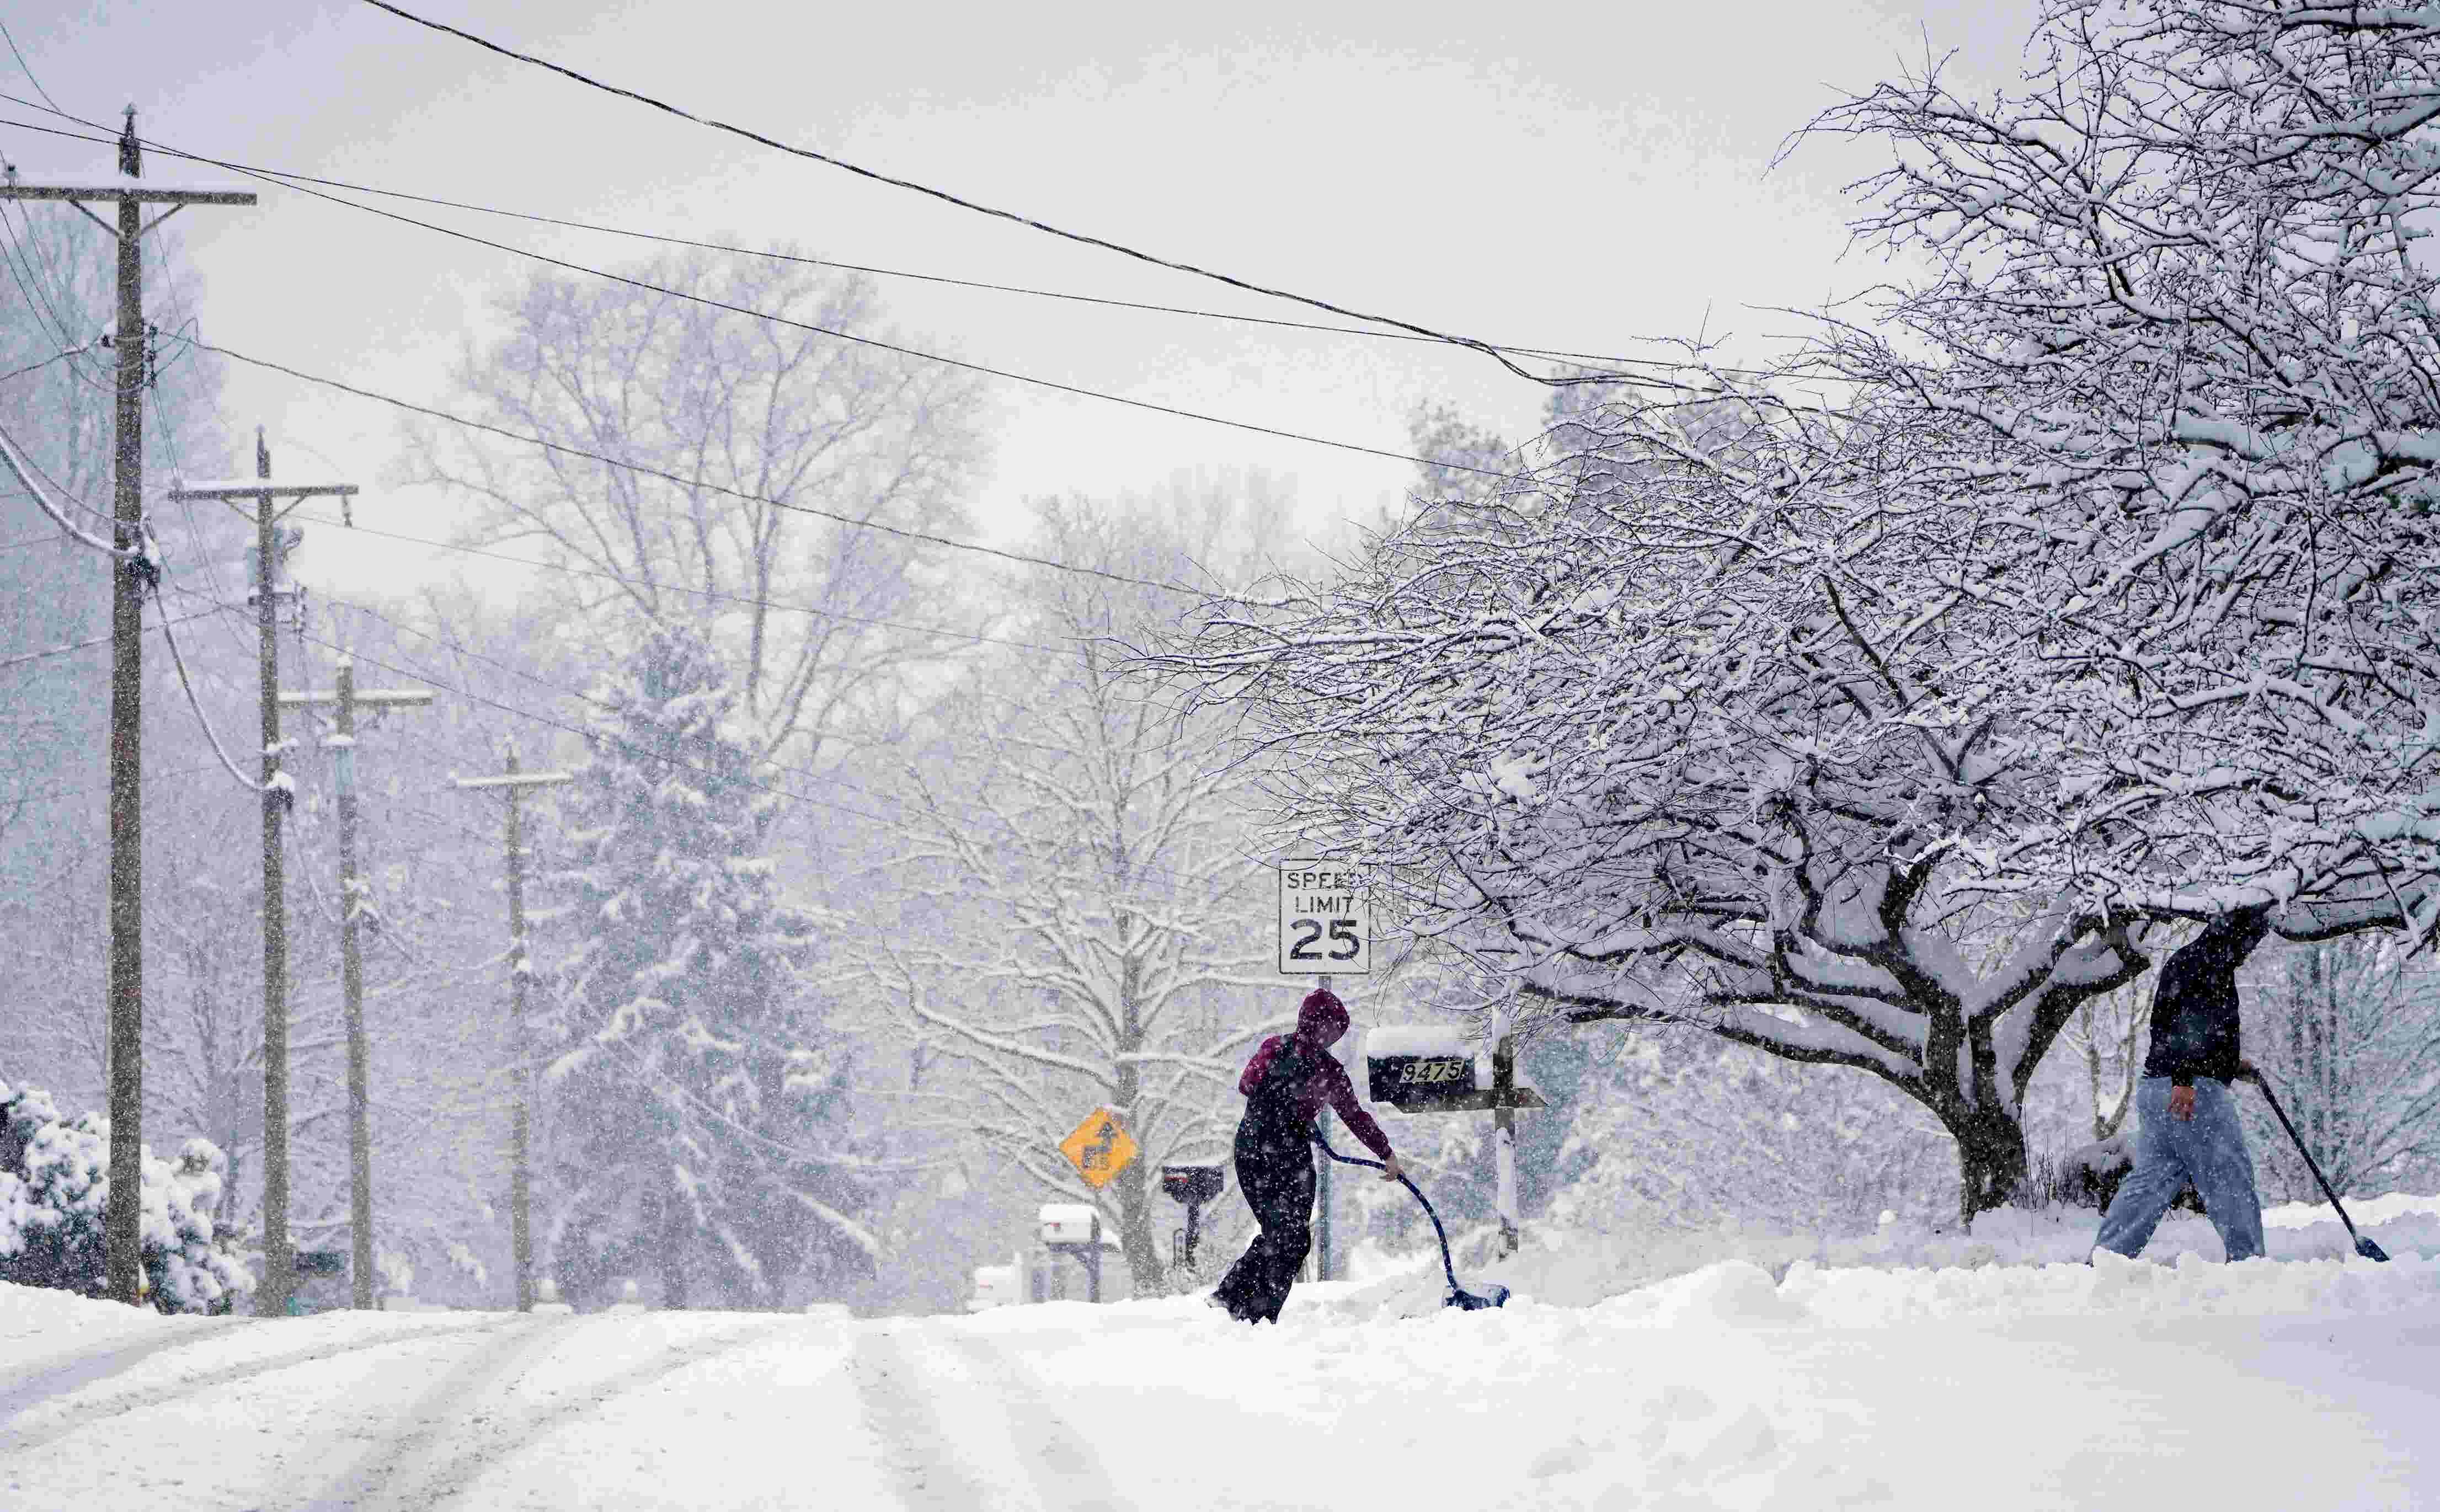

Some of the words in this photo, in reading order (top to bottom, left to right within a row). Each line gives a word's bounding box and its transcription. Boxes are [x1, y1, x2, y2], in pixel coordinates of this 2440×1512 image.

[1296, 896, 1353, 912] LIMIT
[1290, 918, 1360, 960] 25
[1403, 1062, 1461, 1081] 9475
